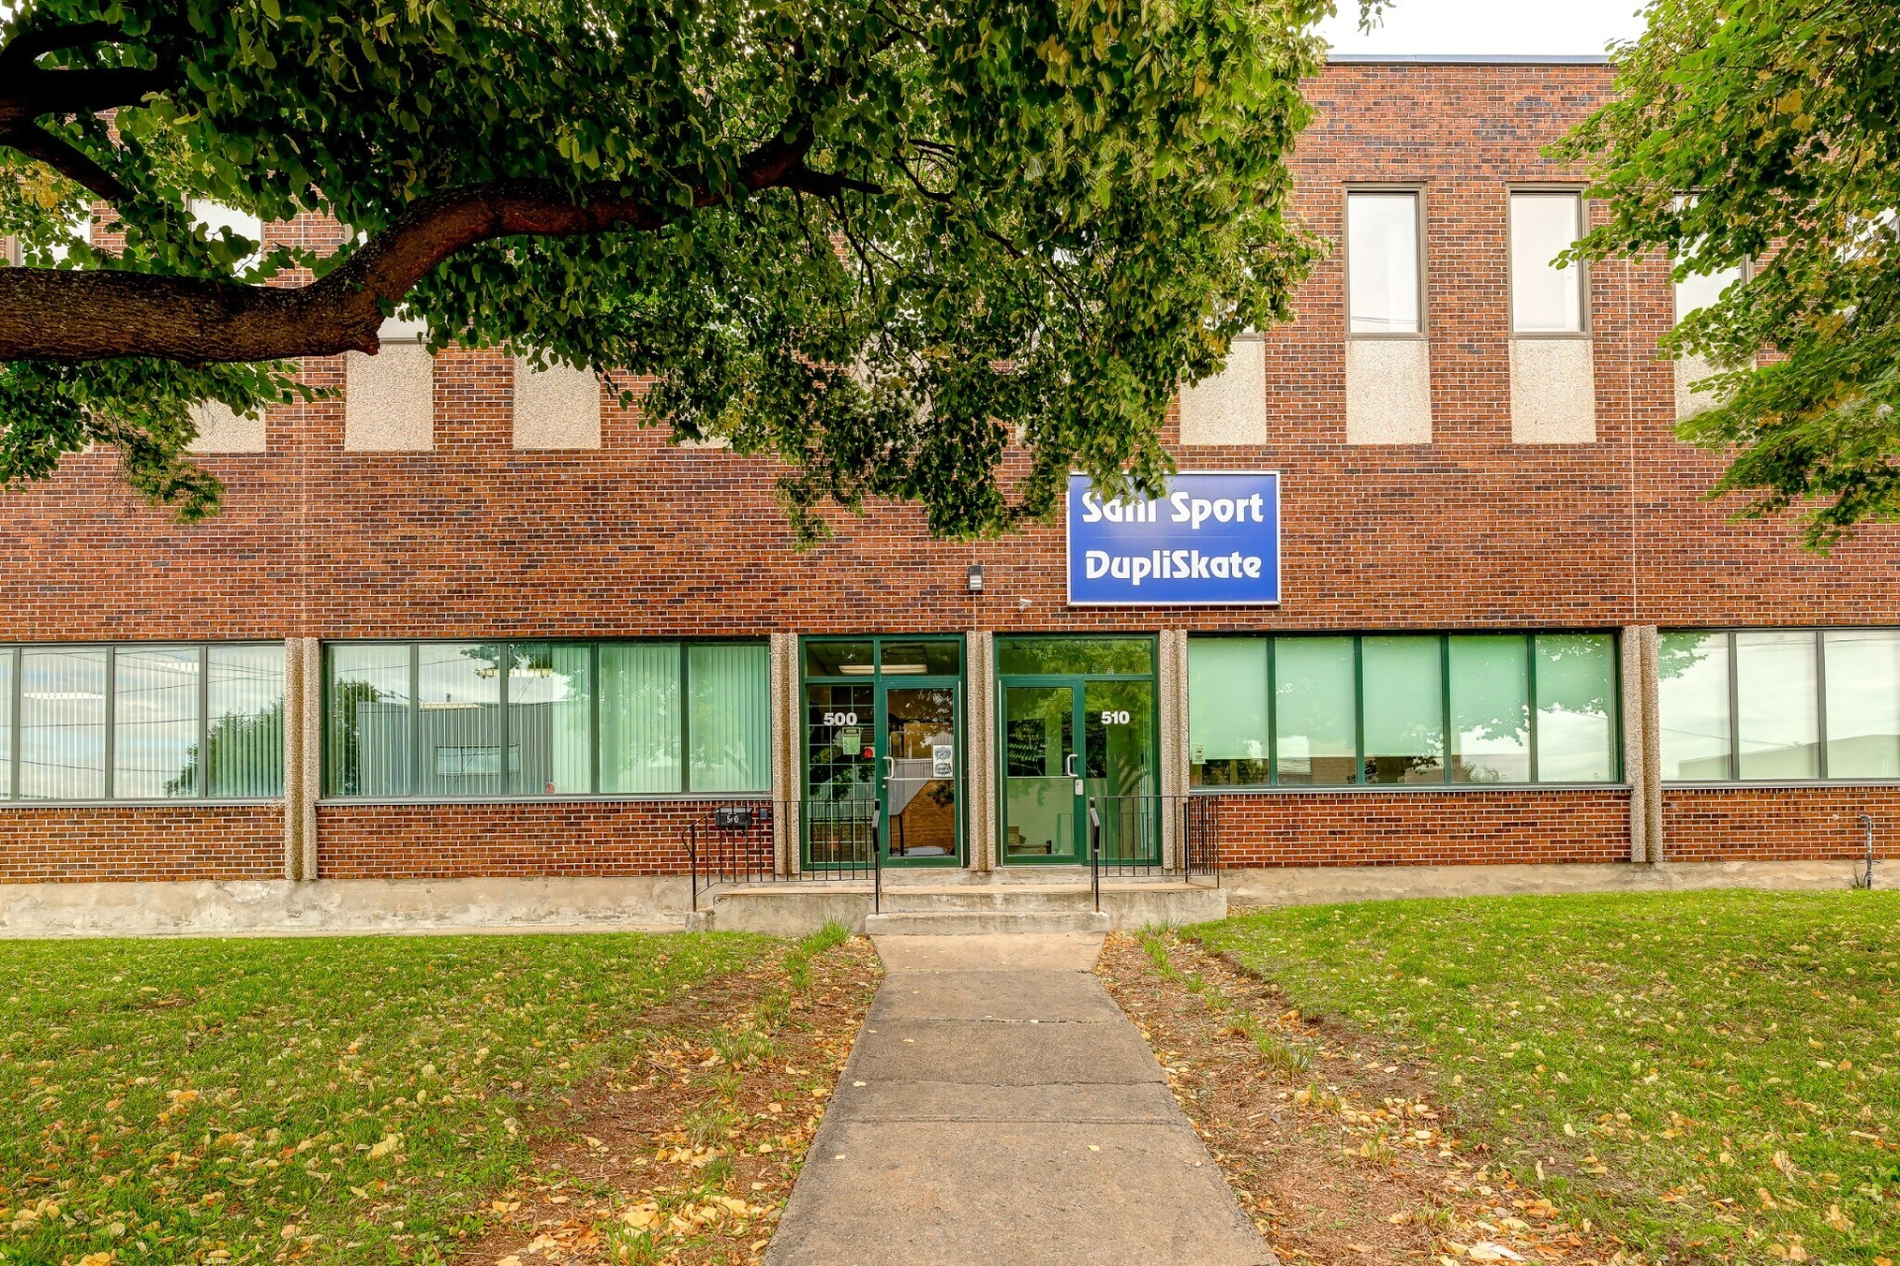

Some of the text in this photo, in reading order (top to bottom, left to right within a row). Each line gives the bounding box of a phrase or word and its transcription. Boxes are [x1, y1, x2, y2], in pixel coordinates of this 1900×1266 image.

[1170, 491, 1265, 530] Sport
[1085, 550, 1263, 586] DupliSkate
[823, 712, 858, 726] 500
[1100, 710, 1130, 725] 510
